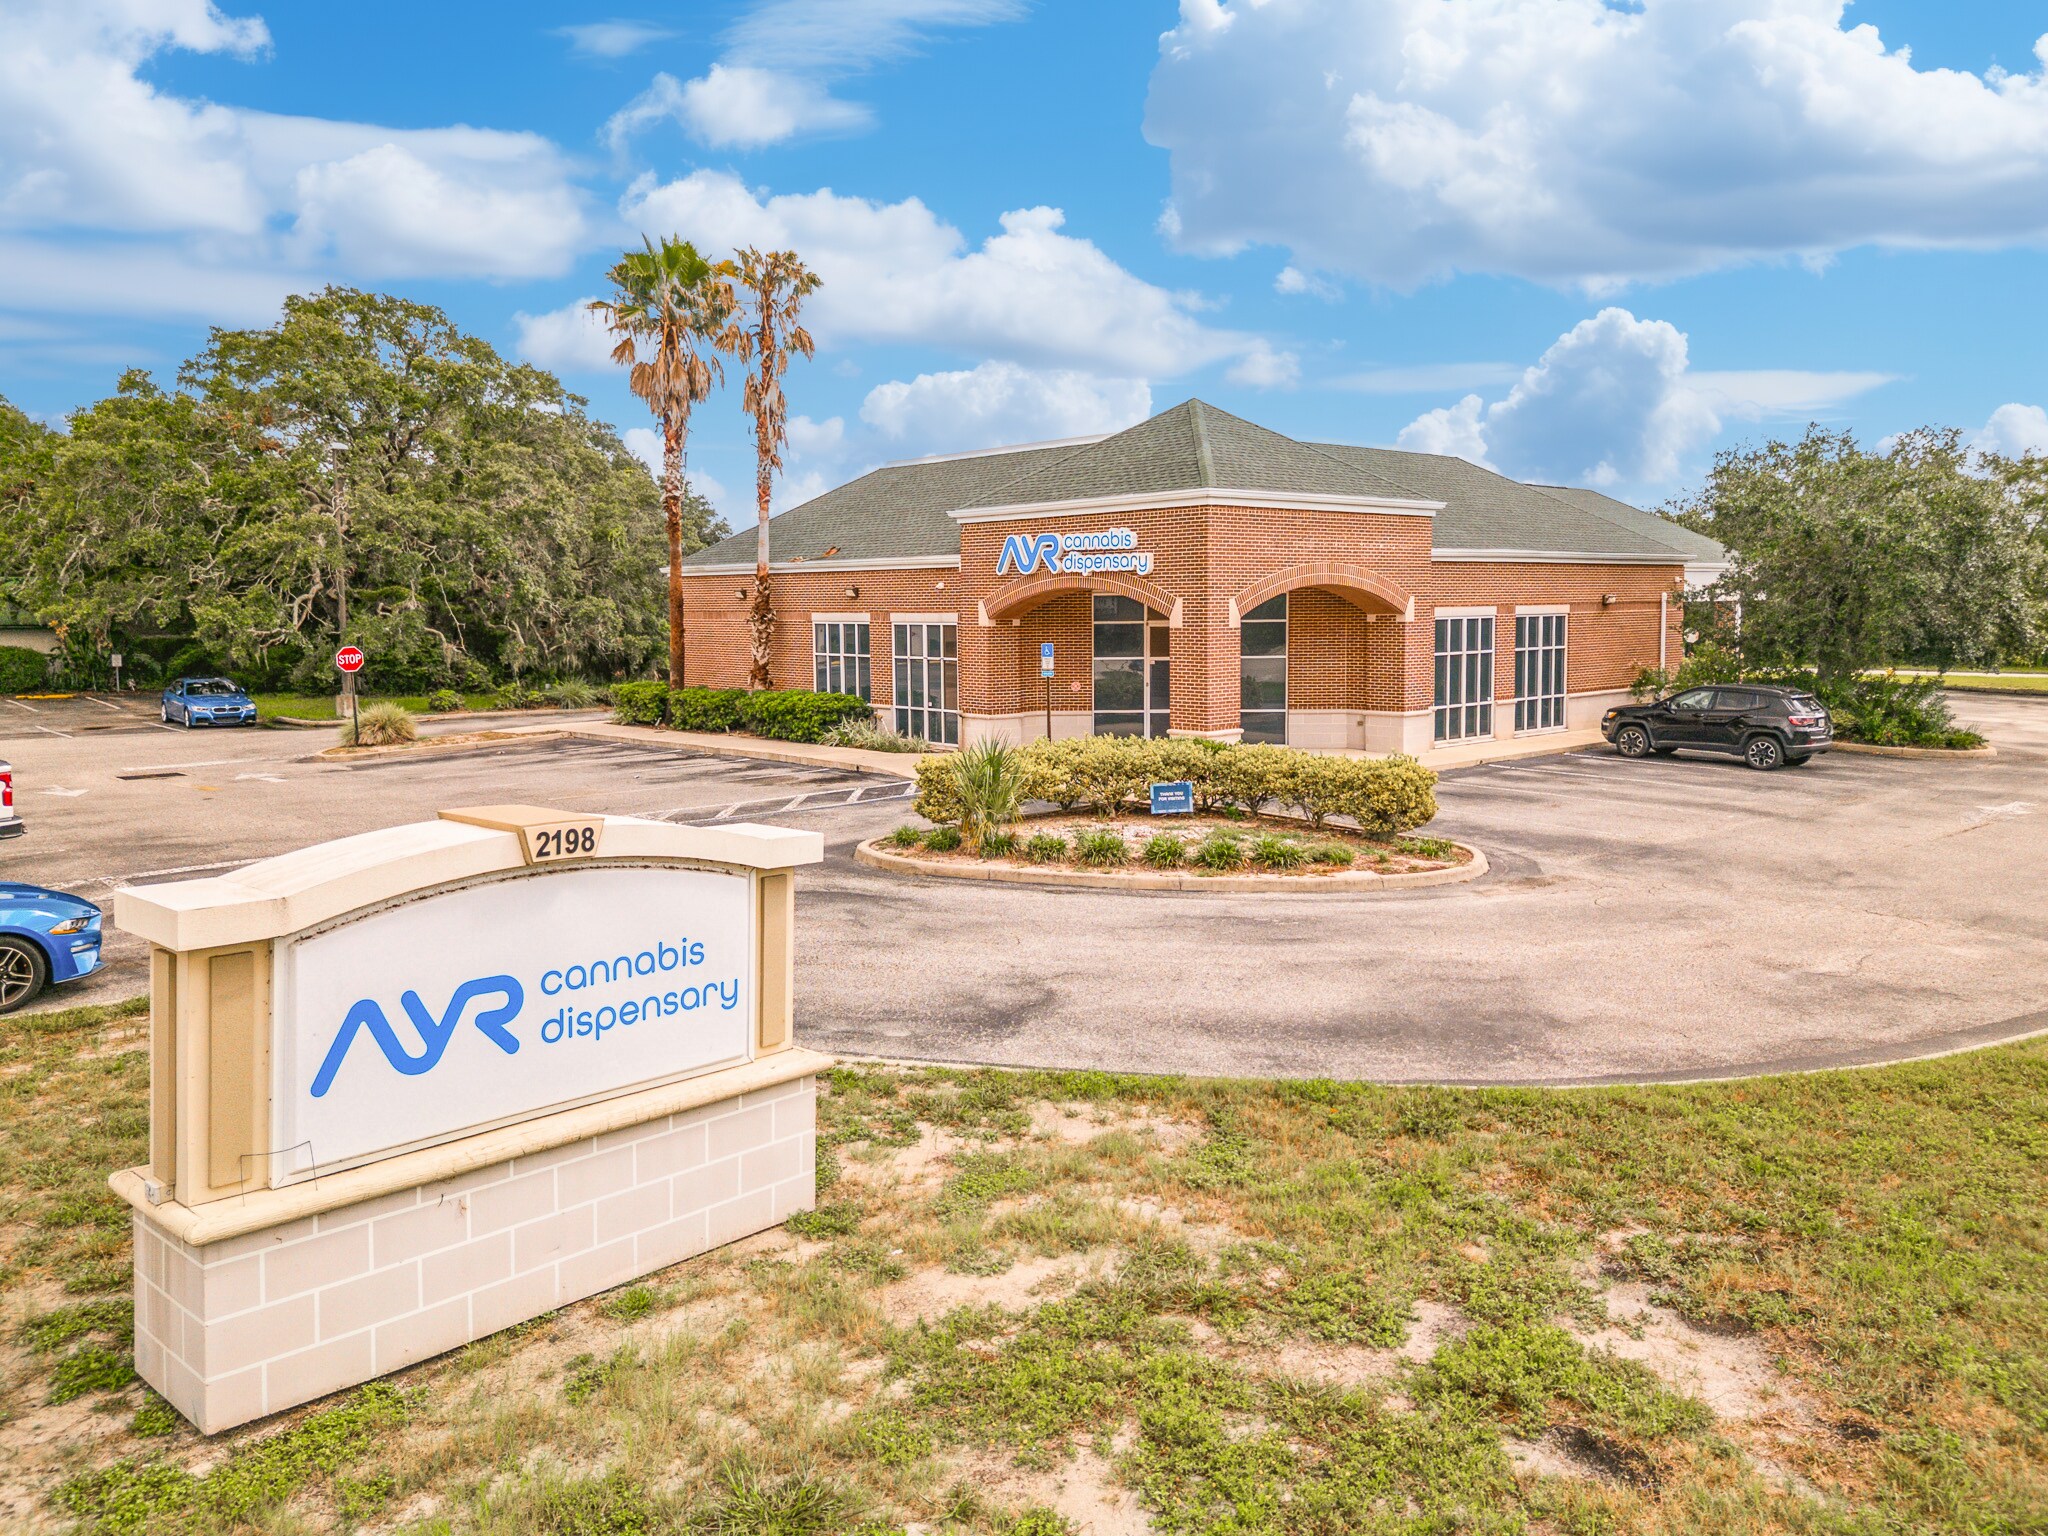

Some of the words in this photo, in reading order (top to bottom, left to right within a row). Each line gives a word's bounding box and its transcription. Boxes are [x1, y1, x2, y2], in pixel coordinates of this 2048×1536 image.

[997, 533, 1060, 573] AYR
[1064, 530, 1132, 549] cannabis
[1064, 554, 1148, 573] dispensary
[338, 653, 362, 665] STOP
[536, 827, 595, 858] 2198
[540, 937, 705, 996] cannabis
[540, 978, 739, 1044] dispensary
[310, 974, 524, 1098] AYR
